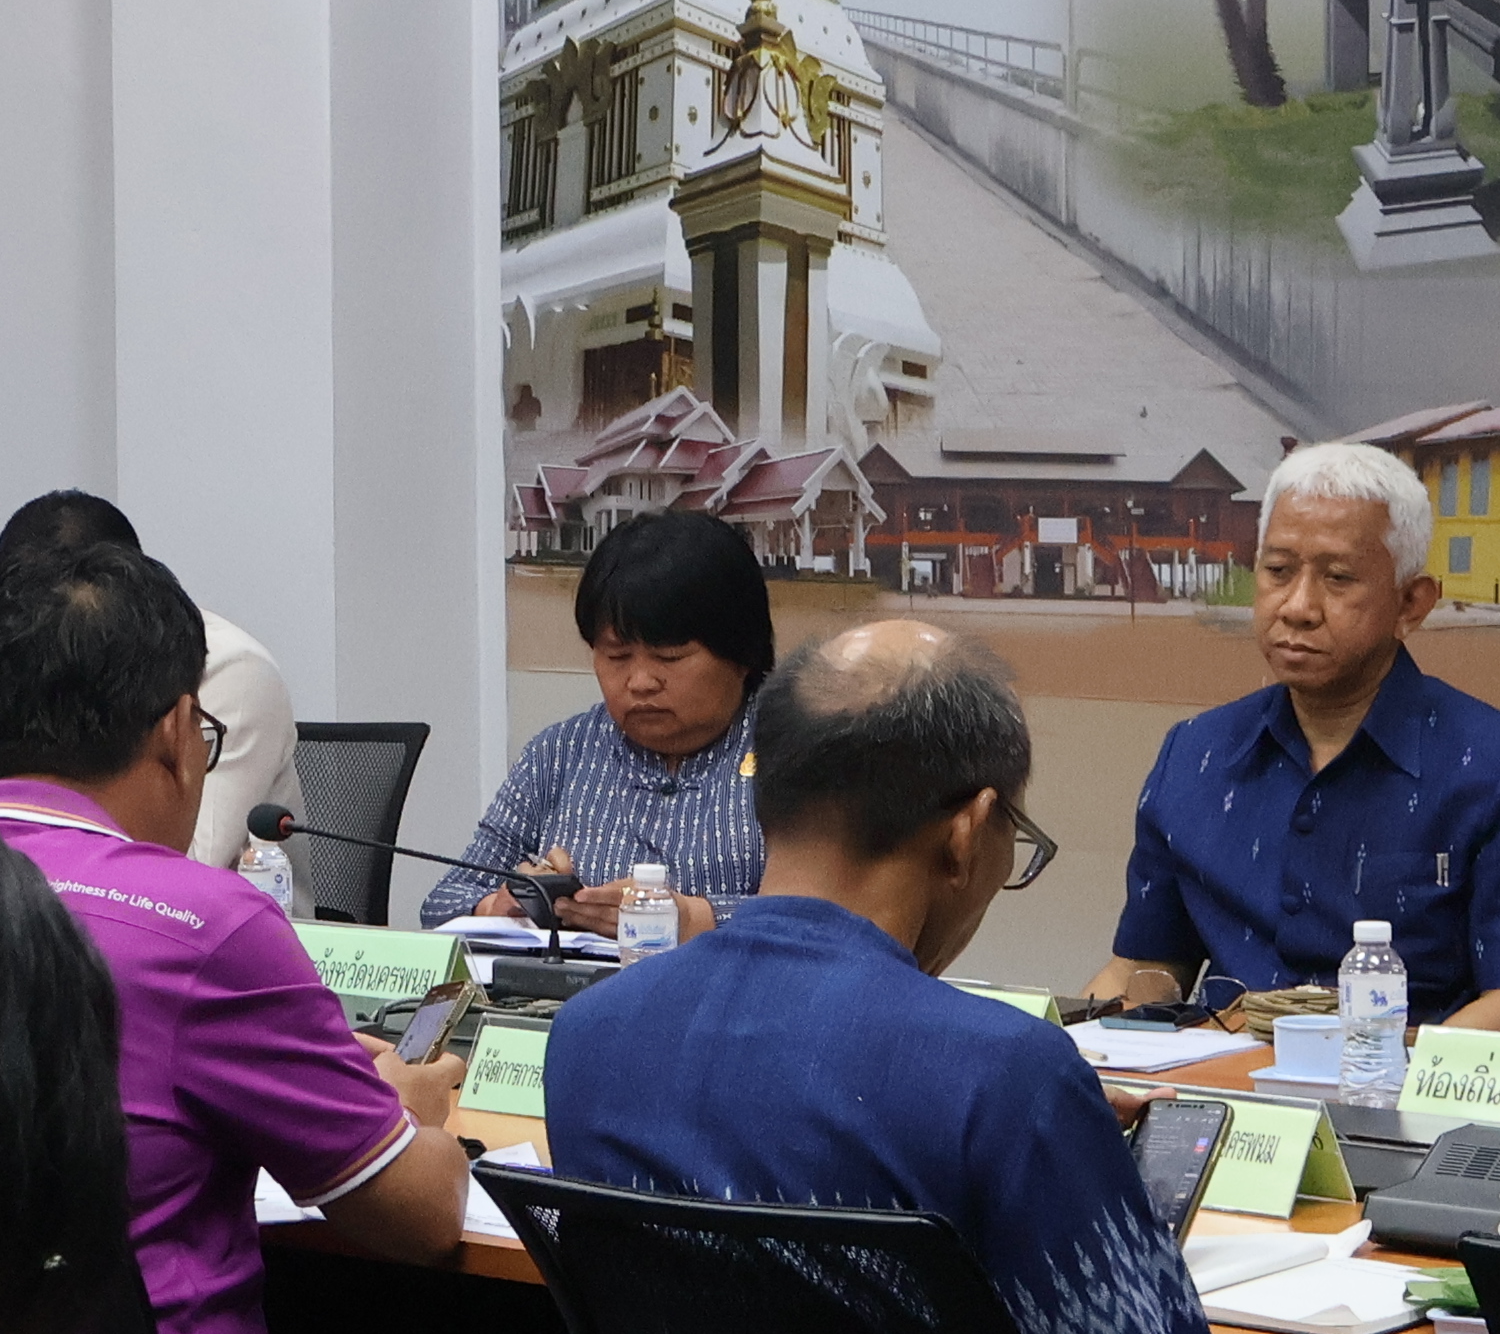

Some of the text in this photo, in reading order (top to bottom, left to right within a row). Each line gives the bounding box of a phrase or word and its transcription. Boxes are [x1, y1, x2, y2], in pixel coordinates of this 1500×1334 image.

[108, 888, 129, 903] for
[129, 893, 154, 911] Life
[155, 902, 206, 930] Quality
[312, 947, 437, 996] จังหวัดนครพนม
[473, 1046, 546, 1095] ผู้จัดการการ
[1219, 1130, 1282, 1165] ครพนม
